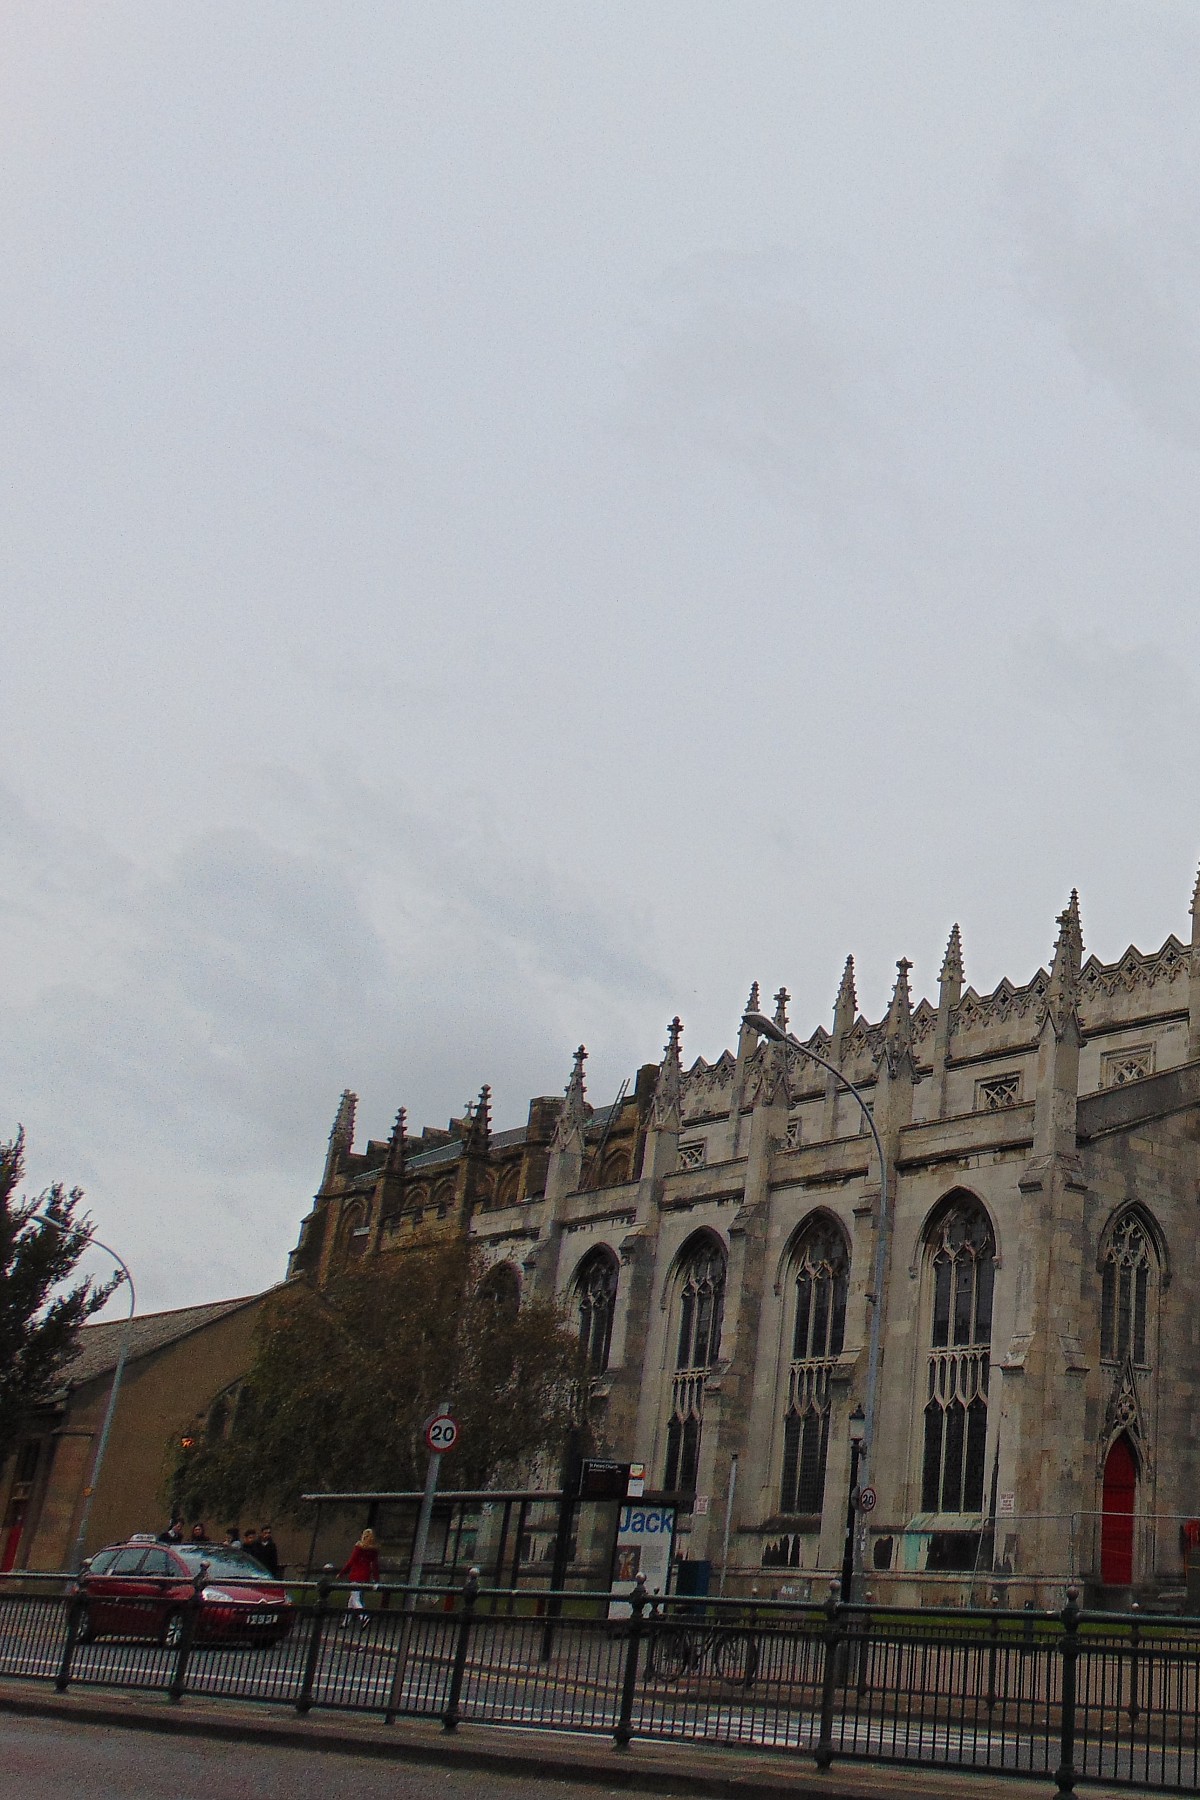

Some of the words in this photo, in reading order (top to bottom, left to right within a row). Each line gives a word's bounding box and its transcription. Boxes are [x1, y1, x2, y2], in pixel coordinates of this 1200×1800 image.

[432, 1425, 454, 1441] 20
[862, 1494, 874, 1505] 20
[618, 1506, 673, 1533] Jack
